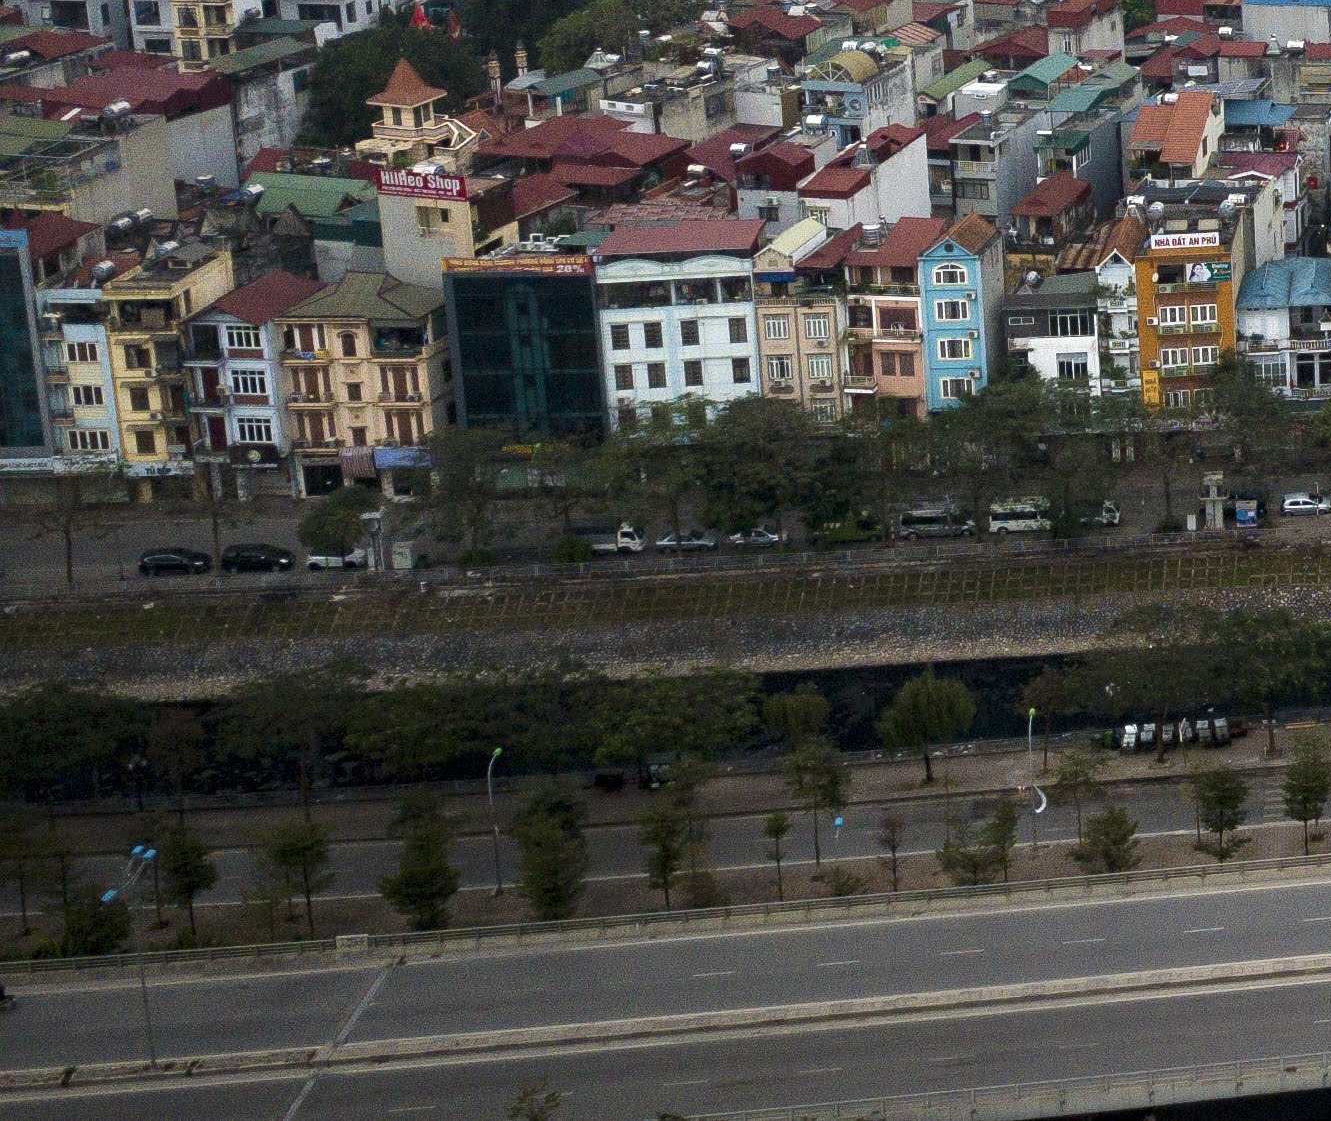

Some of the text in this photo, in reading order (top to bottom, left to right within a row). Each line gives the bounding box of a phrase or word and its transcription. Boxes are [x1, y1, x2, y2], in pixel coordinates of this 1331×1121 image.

[427, 174, 460, 196] Shop
[1154, 237, 1171, 247] NHÀ
[1188, 238, 1200, 246] AN
[1201, 234, 1217, 245] PHÚ
